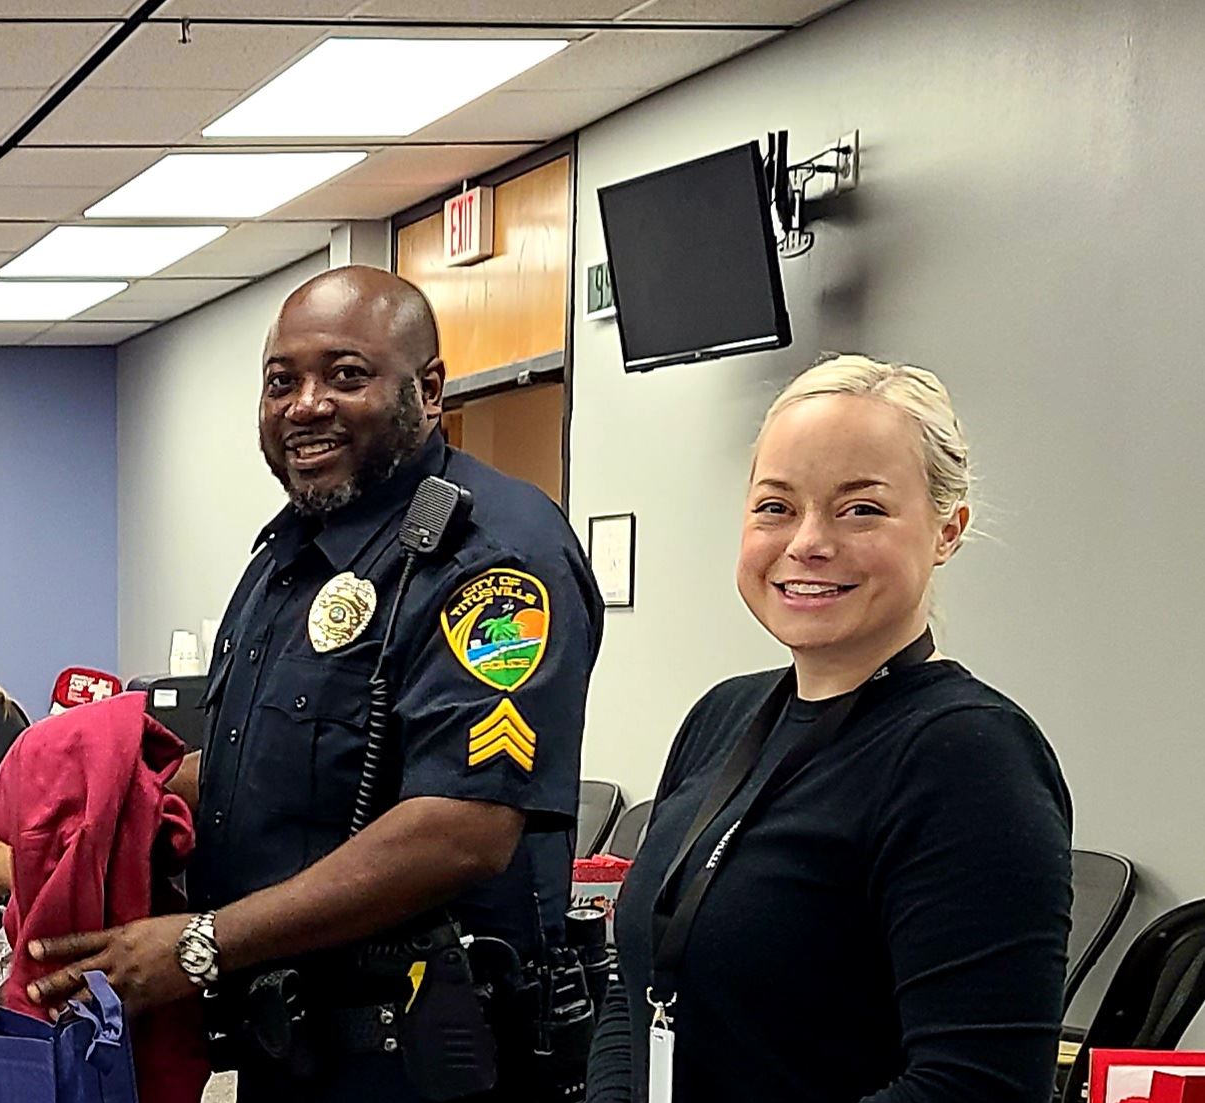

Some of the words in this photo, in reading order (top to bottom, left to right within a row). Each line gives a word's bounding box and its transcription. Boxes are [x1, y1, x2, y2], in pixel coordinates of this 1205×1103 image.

[451, 195, 474, 257] EXIT
[450, 586, 537, 616] TITUSVILLE
[462, 576, 495, 598] CITY
[499, 576, 522, 587] OF
